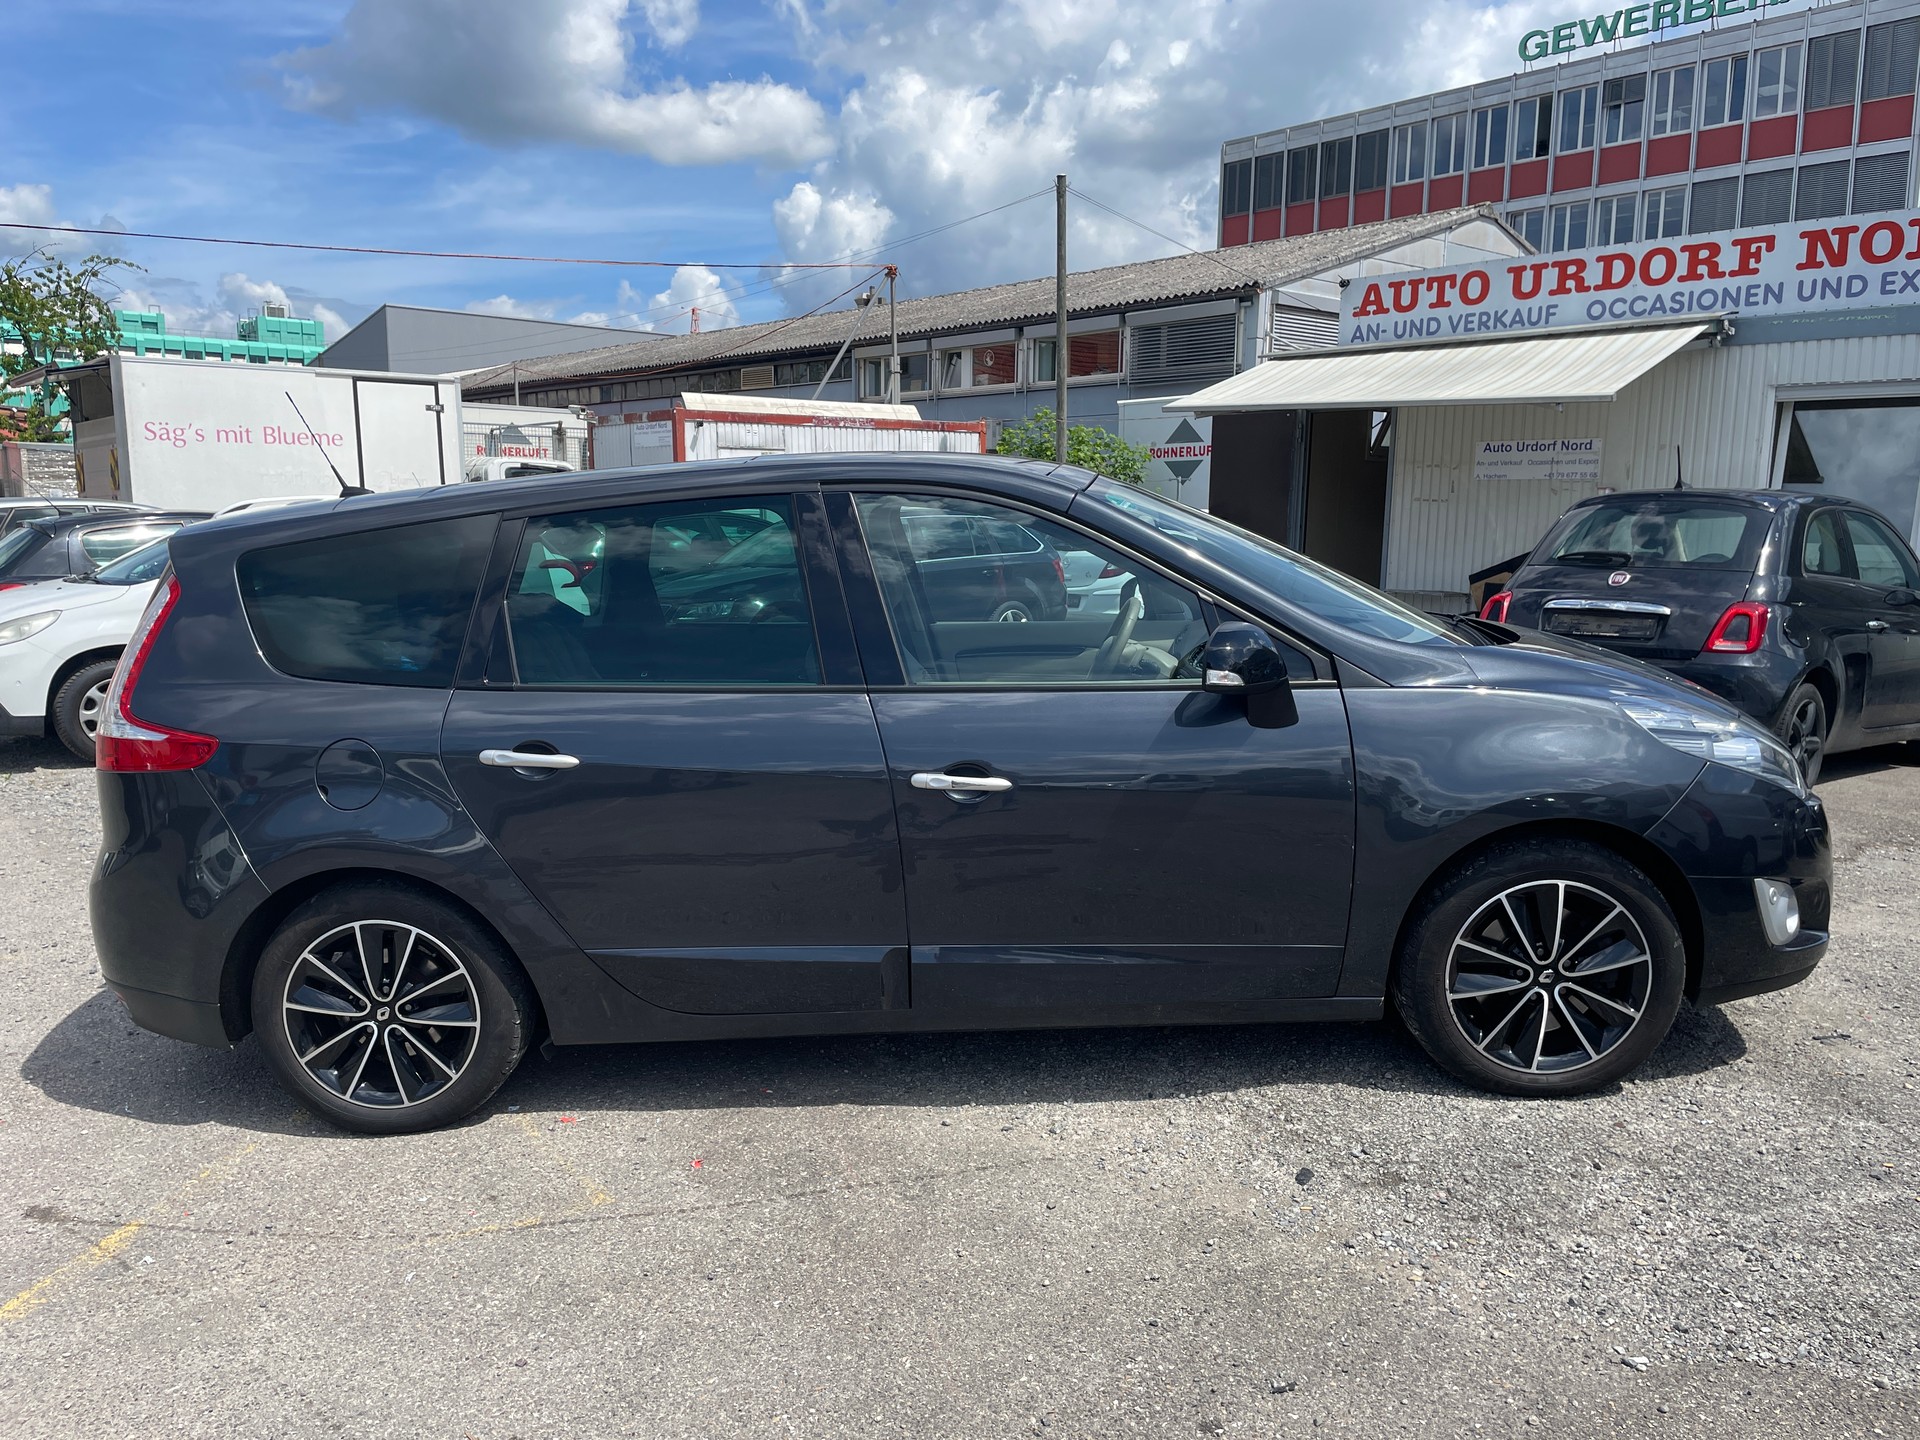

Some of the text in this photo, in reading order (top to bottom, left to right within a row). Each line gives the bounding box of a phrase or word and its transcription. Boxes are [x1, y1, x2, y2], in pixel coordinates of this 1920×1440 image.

[1352, 269, 1491, 318] AUTO
[1506, 234, 1776, 300] URDORF
[1350, 322, 1388, 344] AN-
[1393, 316, 1442, 339] UND
[1448, 304, 1559, 334] VERKAUF
[1586, 281, 1784, 321] OCCASIONEN
[1797, 274, 1869, 302] UND
[216, 425, 253, 444] mit
[262, 425, 344, 447] Blueme
[1483, 439, 1593, 453] Auto Urdorf Nord
